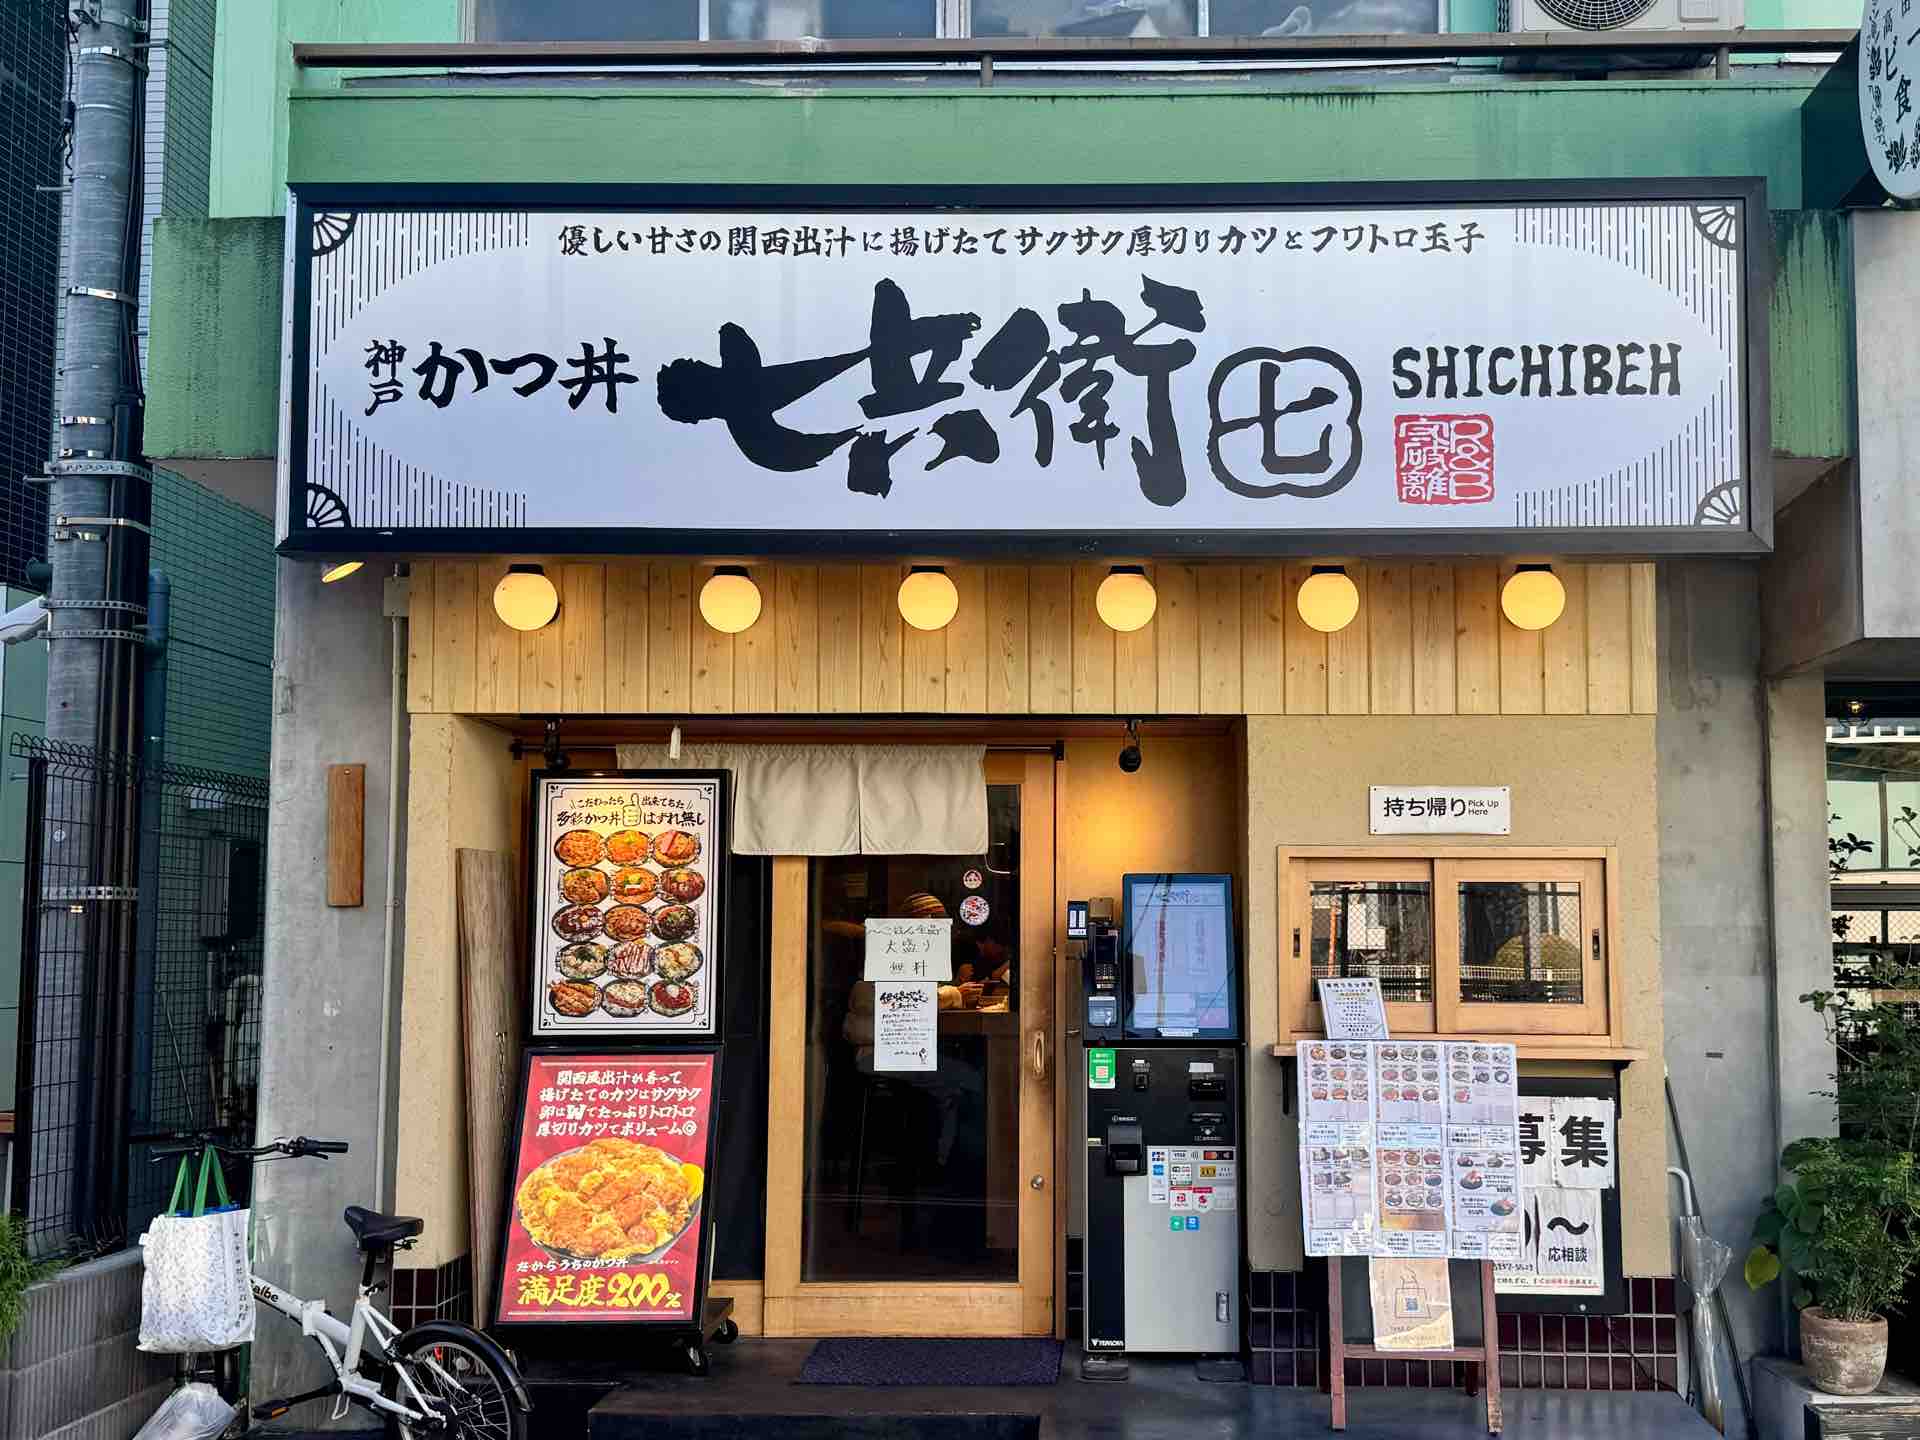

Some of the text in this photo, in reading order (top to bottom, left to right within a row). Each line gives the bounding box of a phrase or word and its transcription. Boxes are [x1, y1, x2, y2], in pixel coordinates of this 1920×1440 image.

[558, 223, 1486, 259] 優しい甘さの関西出汁に揚げたてサクサク厚切りカツとフワトロ玉子
[364, 338, 406, 418] 神戸
[410, 336, 640, 414] かつ丼
[656, 273, 1207, 507] 七兵衛
[1392, 342, 1682, 399] SHICHIBEH
[1383, 797, 1466, 817] 持ち帰り
[1468, 799, 1499, 809] Pick Up
[1548, 1246, 1588, 1263] 応相談
